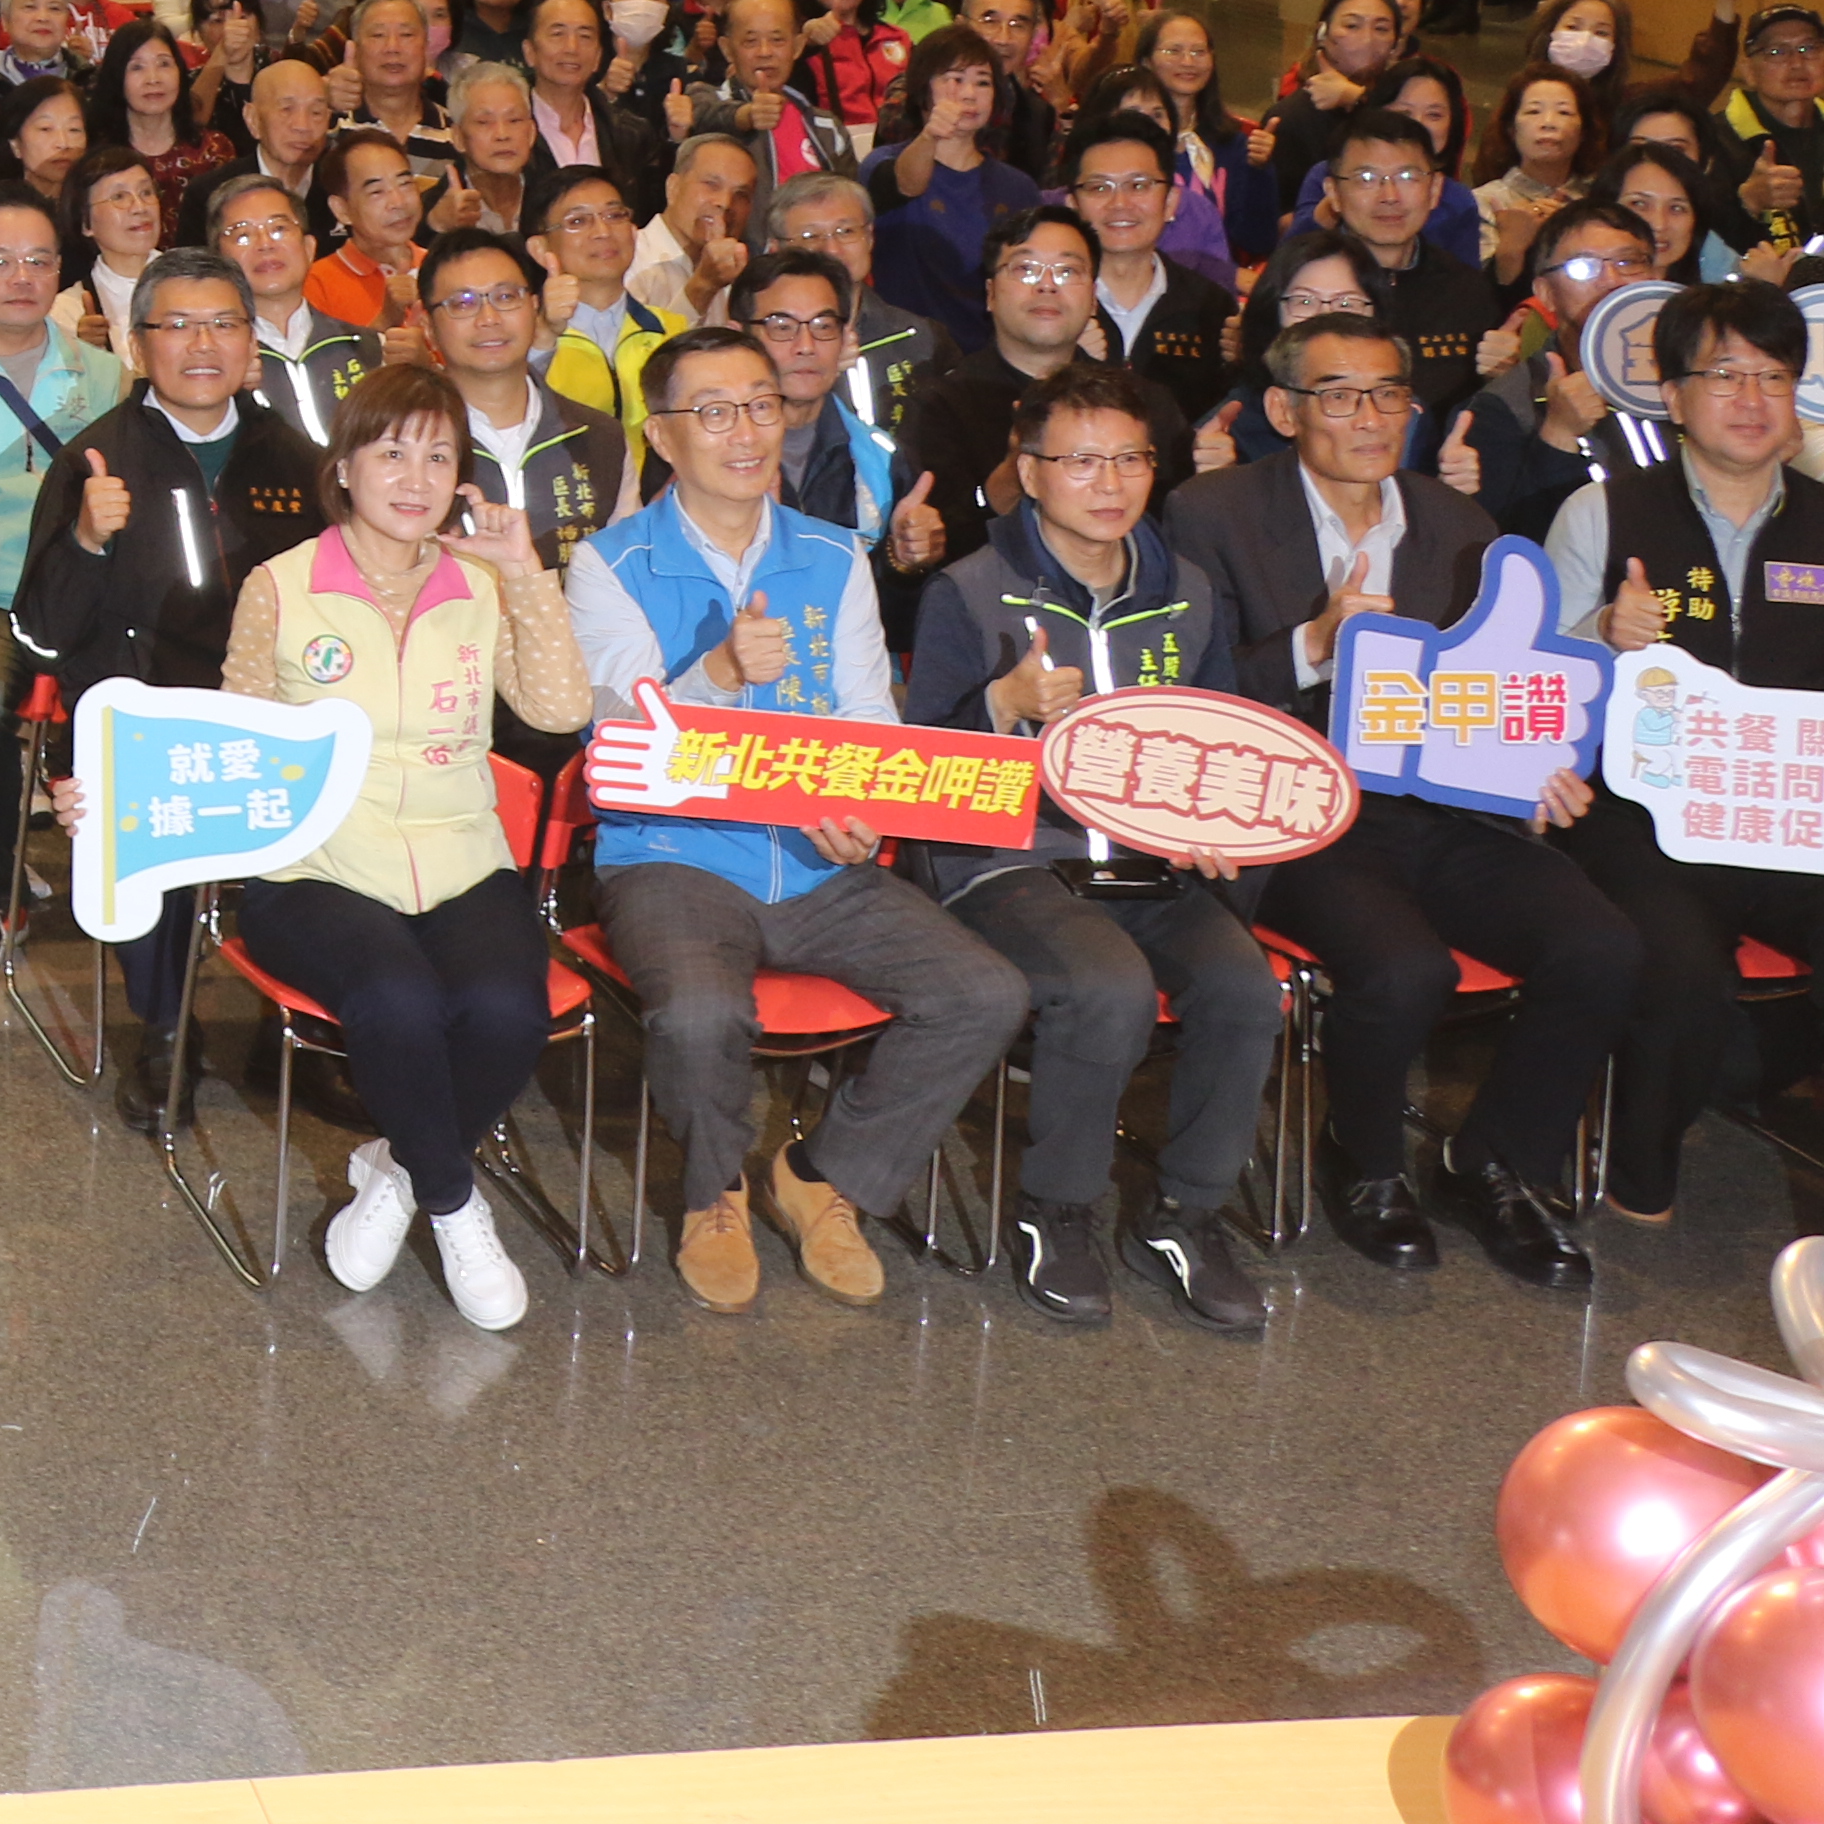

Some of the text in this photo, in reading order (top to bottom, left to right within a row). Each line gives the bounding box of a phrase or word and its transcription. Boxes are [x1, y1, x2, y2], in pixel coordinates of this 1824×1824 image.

[1686, 567, 1715, 620] 特助
[1162, 632, 1180, 686] 五股
[1360, 672, 1569, 745] 金甲讚
[1685, 710, 1776, 754] 共餐
[167, 739, 262, 785] 就愛
[668, 729, 1034, 817] 新北共餐金呷讚
[1065, 724, 1331, 834] 營養美味
[1685, 755, 1824, 804] 電話問
[1682, 801, 1824, 850] 健康促
